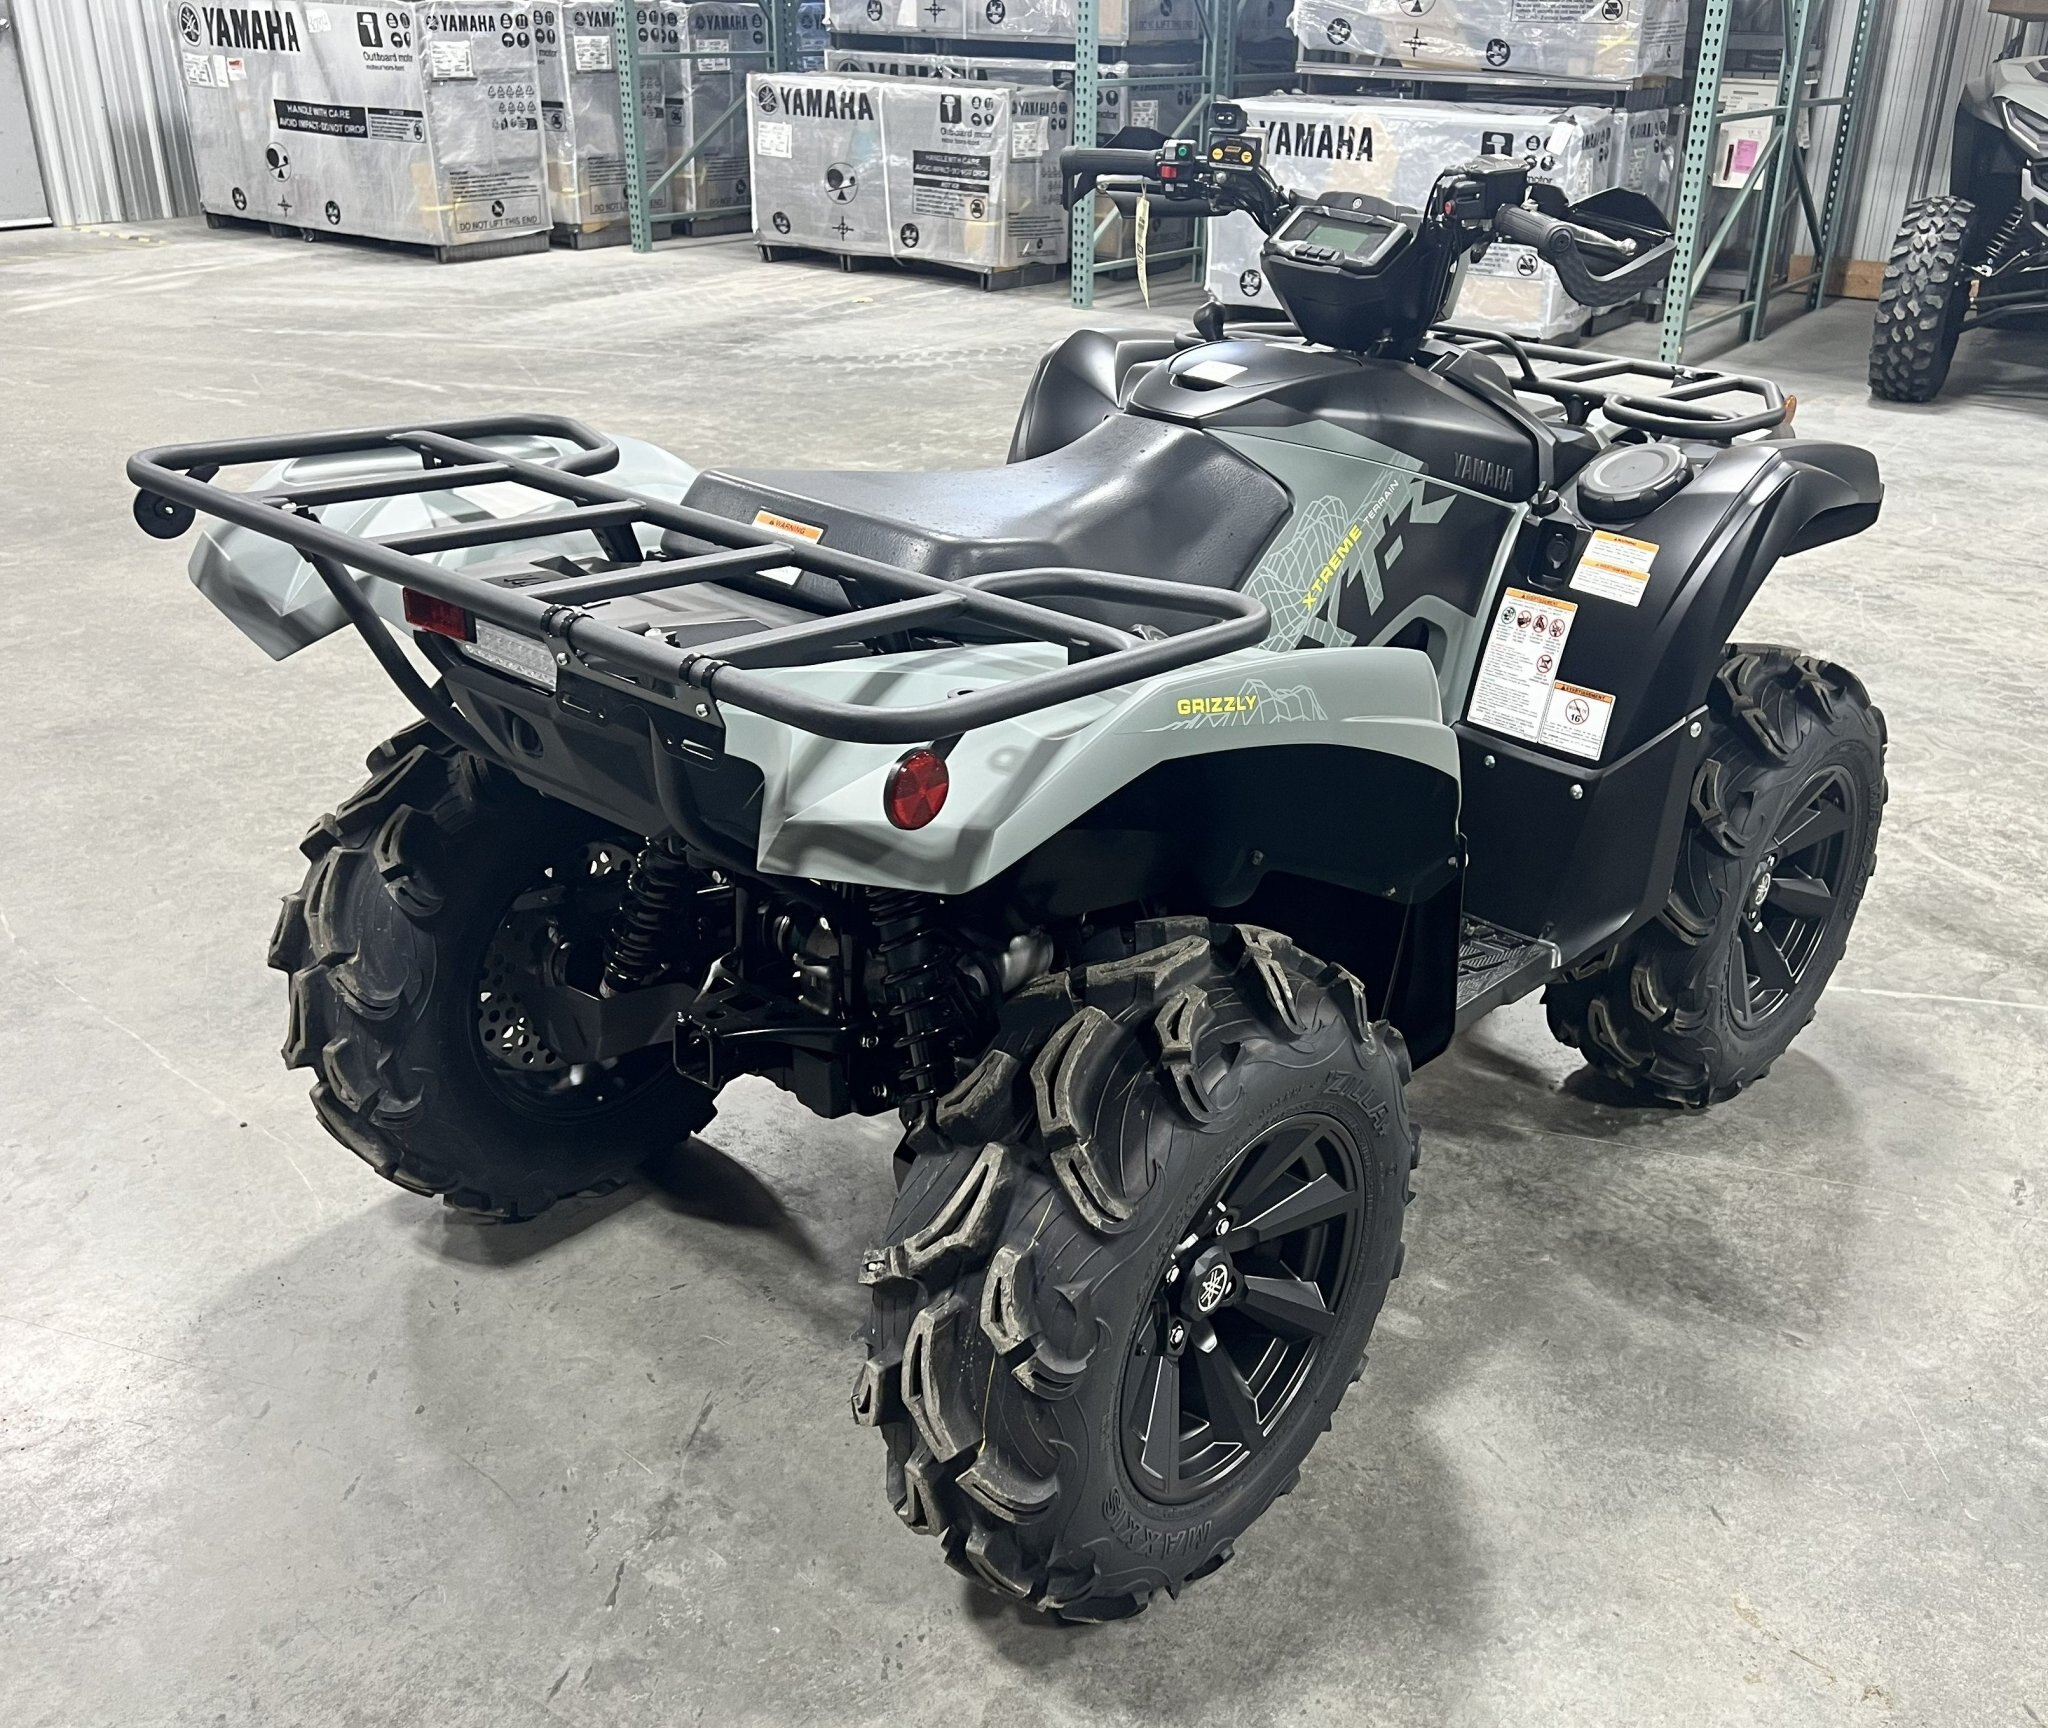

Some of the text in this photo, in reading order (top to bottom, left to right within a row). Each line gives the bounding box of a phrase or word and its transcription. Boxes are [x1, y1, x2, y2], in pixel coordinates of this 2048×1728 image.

[201, 7, 300, 52] YAMAHA
[440, 15, 496, 32] YAMAHA
[706, 15, 749, 30] YAMAHA
[328, 109, 351, 120] CARE
[780, 87, 875, 121] YAMAHA
[344, 124, 366, 135] DROP
[1259, 120, 1373, 162] YAMAHA
[460, 215, 538, 231] DO NOT LIFT THIS END
[1454, 451, 1514, 493] YAMAHA
[1363, 479, 1400, 524] TERRAIN
[775, 520, 806, 535] WARNING
[1176, 695, 1257, 716] GRIZZLY
[1571, 713, 1581, 723] 16
[1323, 1070, 1388, 1130] ZILLA
[1102, 1486, 1212, 1560] MAXXIS
